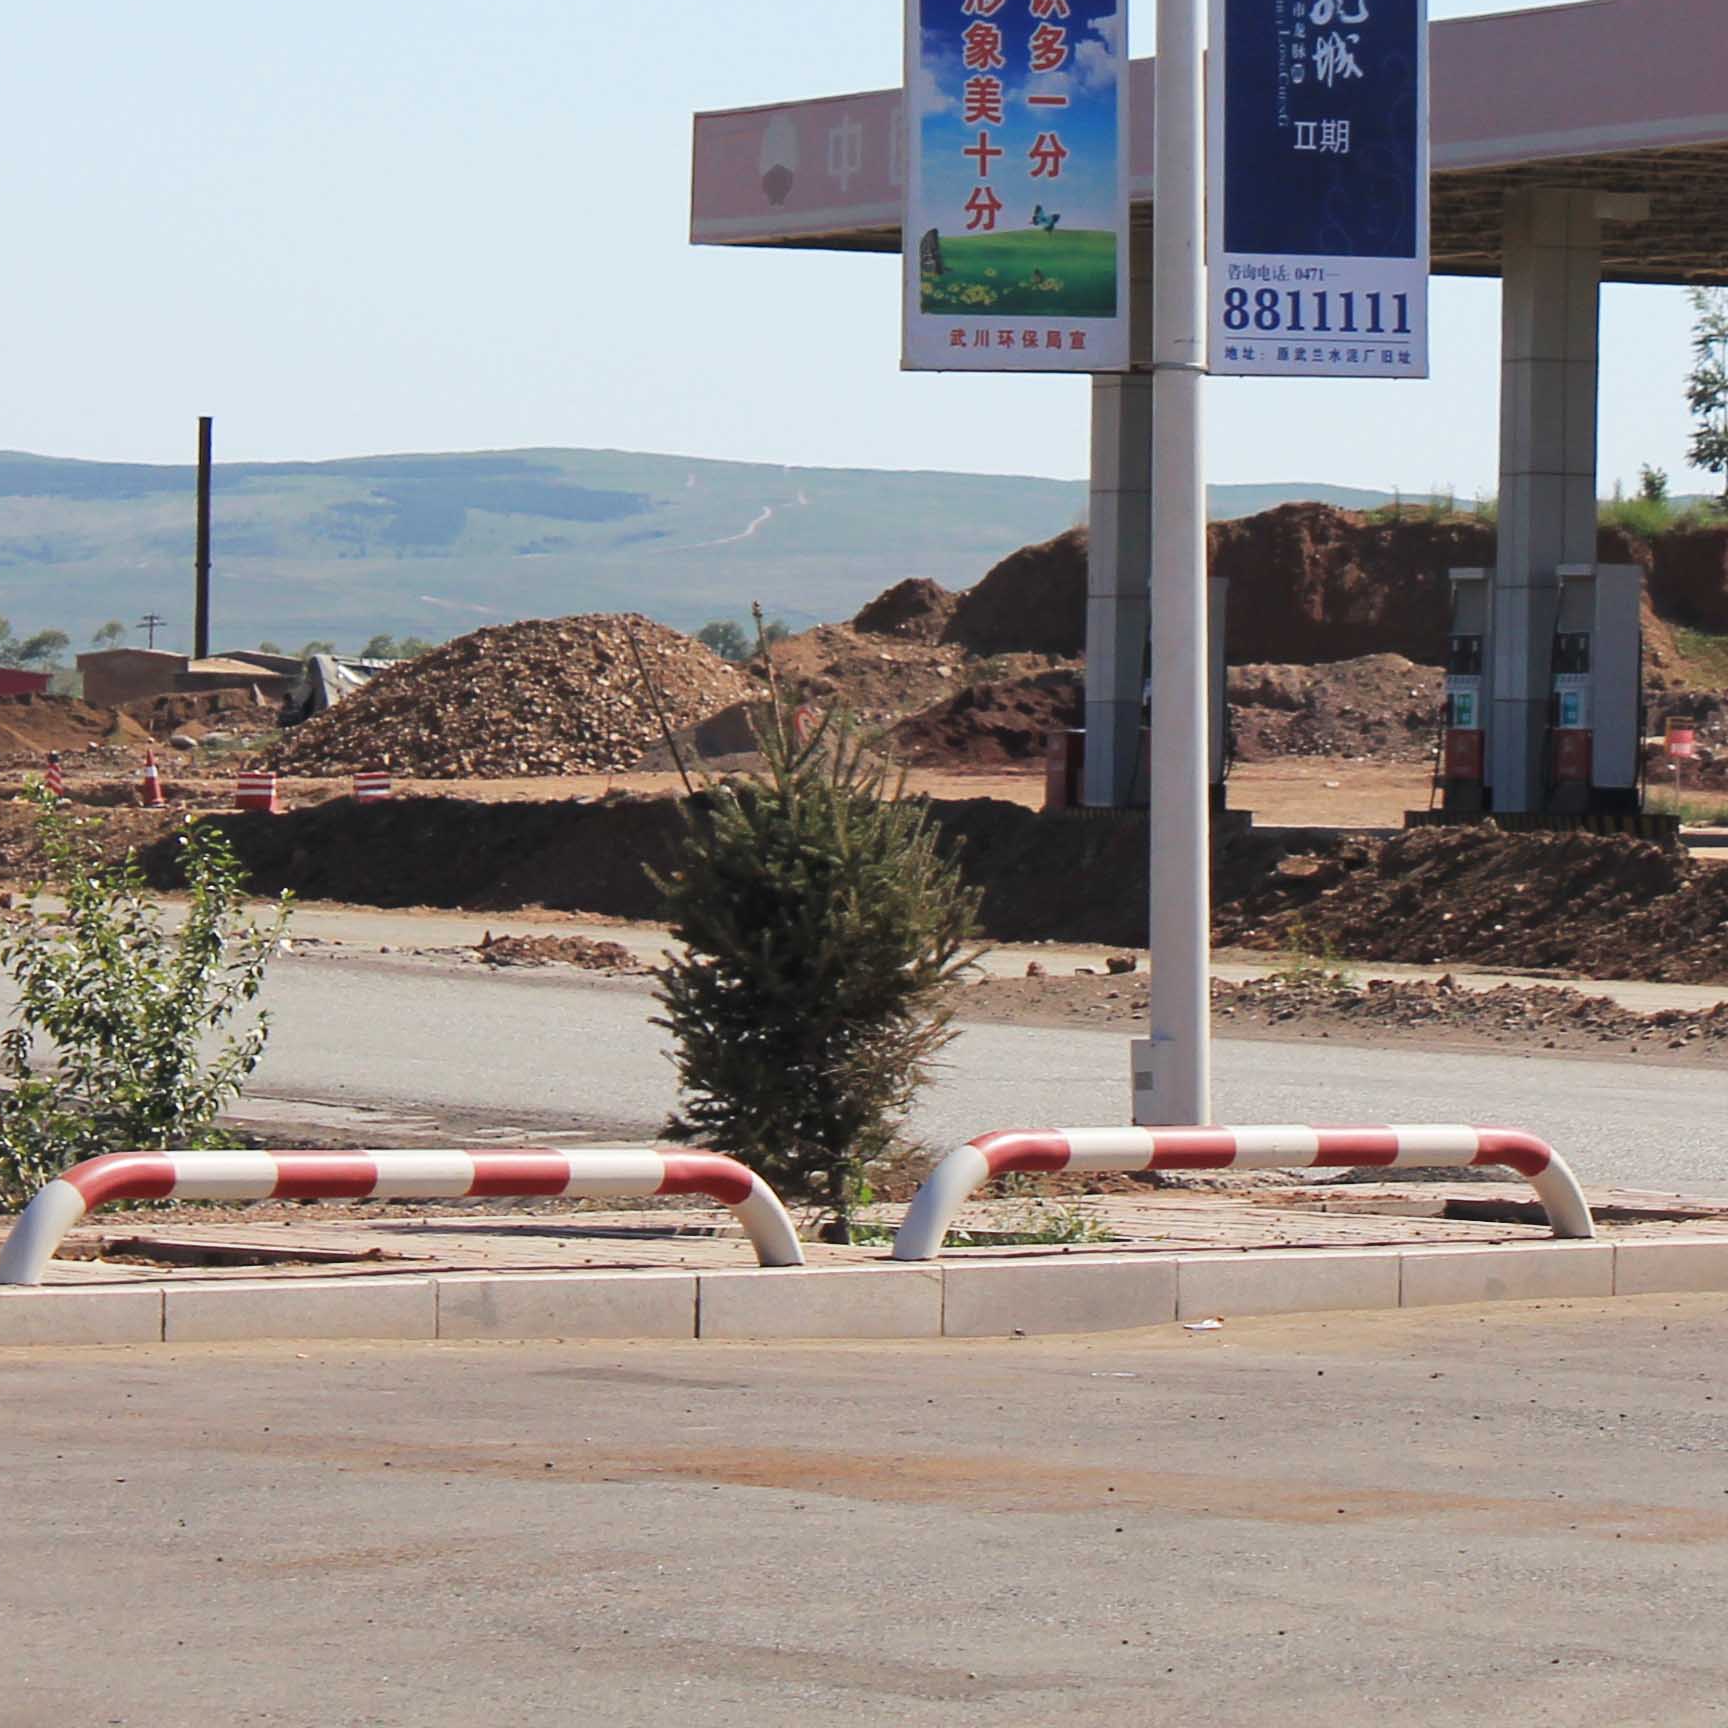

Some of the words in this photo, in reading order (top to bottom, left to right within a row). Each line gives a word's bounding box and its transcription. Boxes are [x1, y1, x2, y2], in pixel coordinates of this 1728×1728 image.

[1223, 287, 1411, 334] 8811111
[949, 328, 1087, 351] 武川环保局宣
